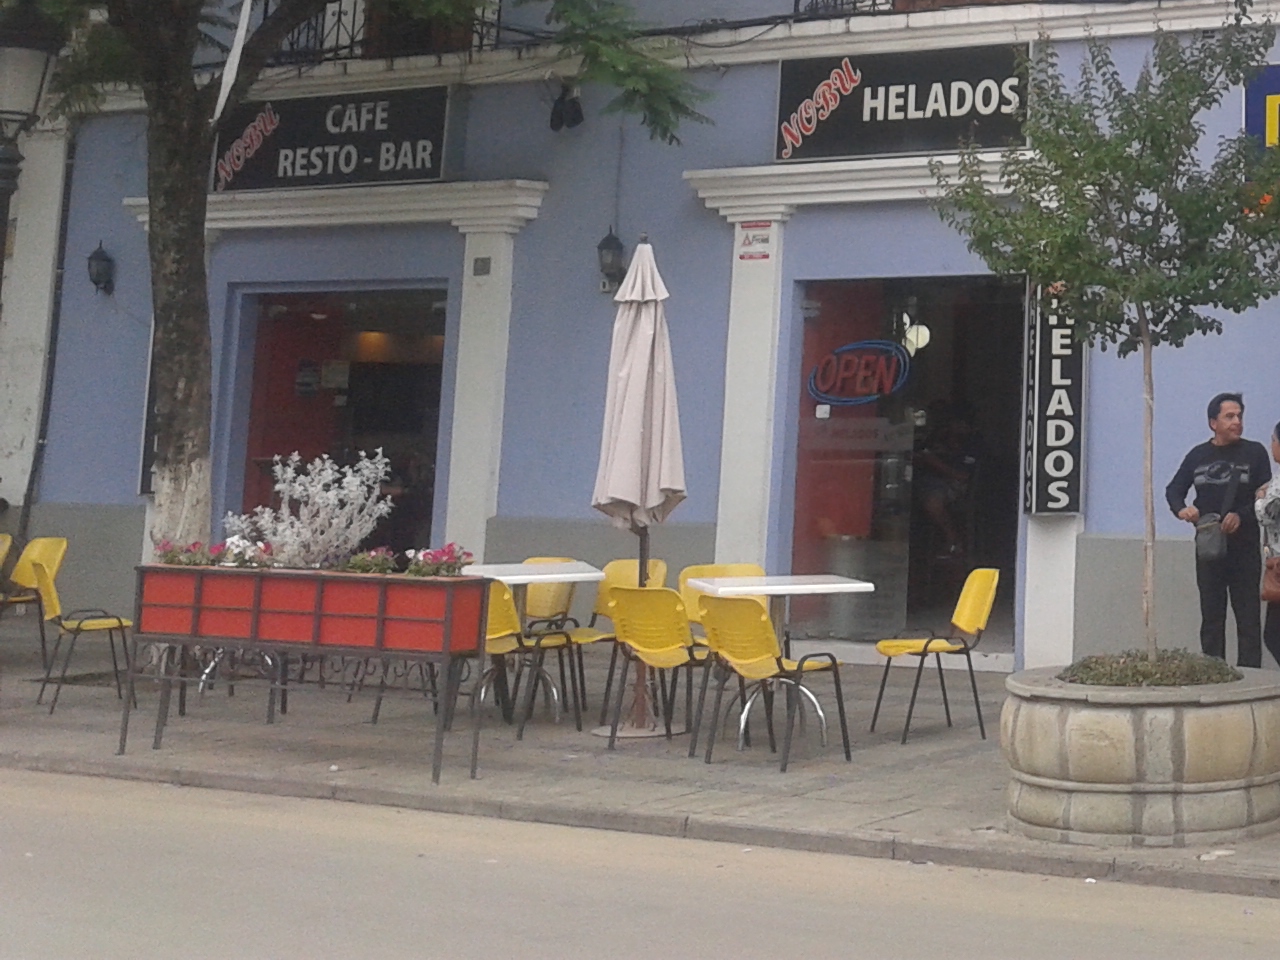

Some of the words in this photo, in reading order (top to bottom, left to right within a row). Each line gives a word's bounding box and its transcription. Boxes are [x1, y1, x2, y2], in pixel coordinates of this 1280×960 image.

[325, 101, 390, 135] CAFE
[781, 57, 861, 158] NOBU
[863, 77, 1020, 121] HELADOS
[216, 102, 280, 191] NOBU
[278, 144, 358, 178] RESTO
[379, 139, 433, 171] BAR
[816, 354, 898, 395] OPEN
